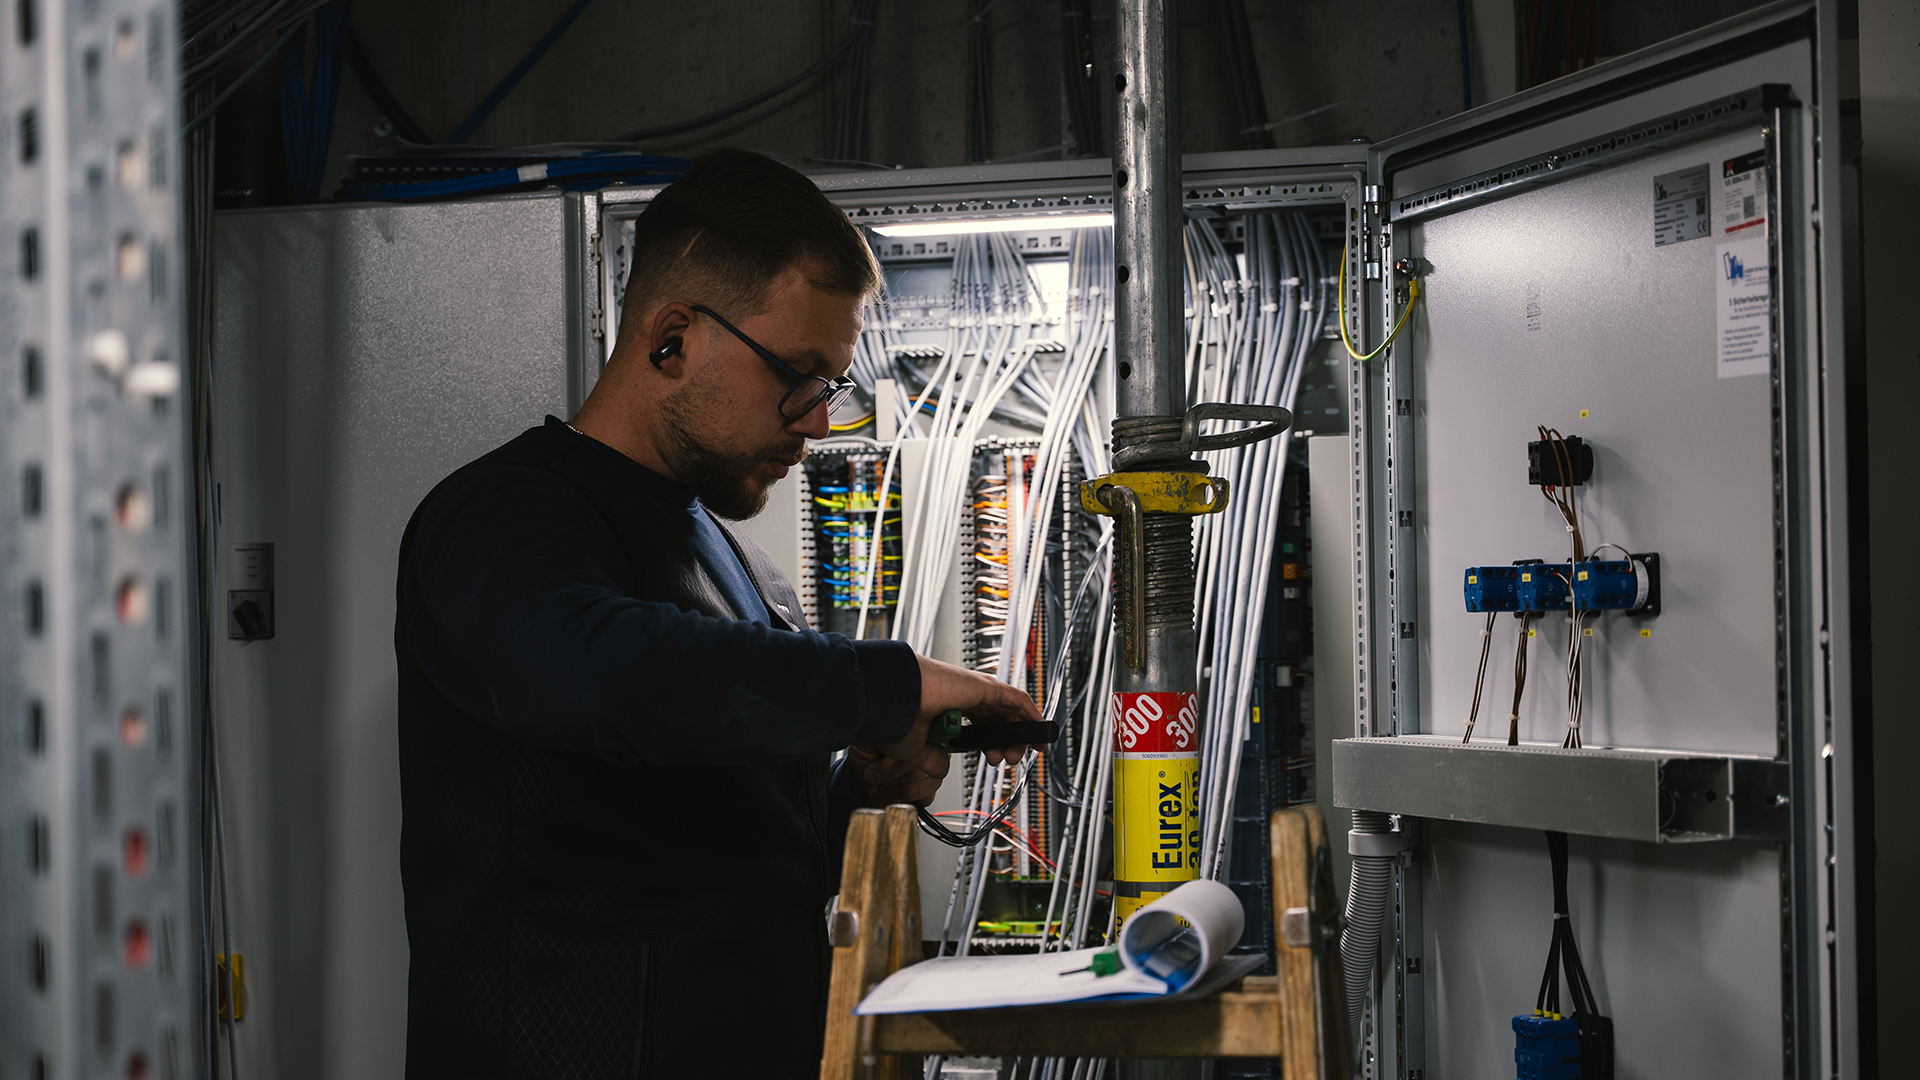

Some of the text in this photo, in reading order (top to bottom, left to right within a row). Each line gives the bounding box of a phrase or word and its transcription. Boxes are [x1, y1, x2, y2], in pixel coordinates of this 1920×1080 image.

[1115, 138, 1125, 158] 3
[1116, 234, 1126, 252] 4
[1118, 329, 1128, 349] 5
[1119, 694, 1163, 749] 300
[1166, 693, 1198, 748] 300
